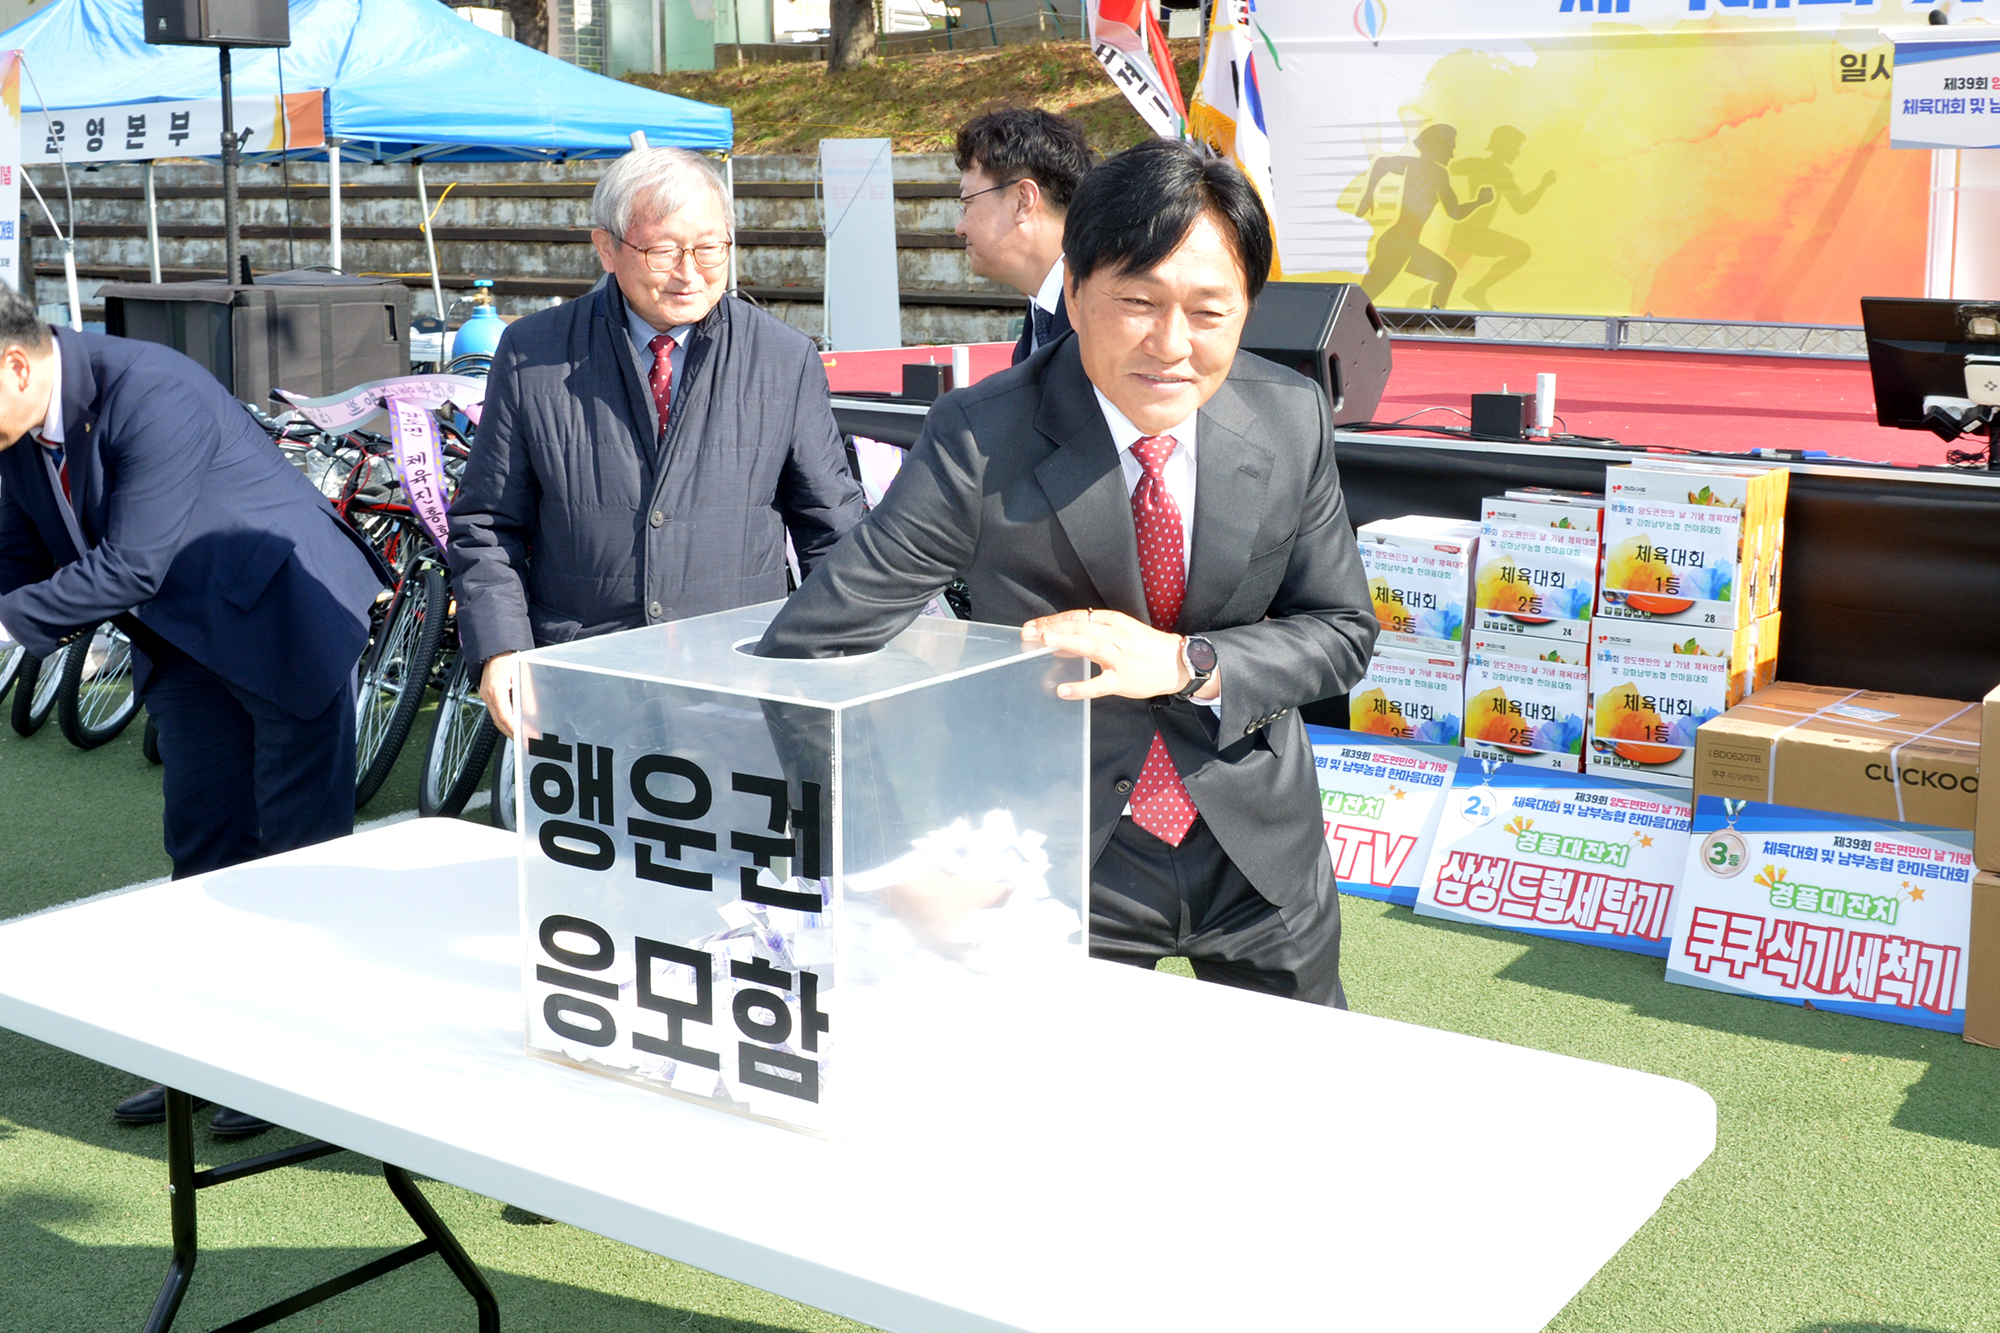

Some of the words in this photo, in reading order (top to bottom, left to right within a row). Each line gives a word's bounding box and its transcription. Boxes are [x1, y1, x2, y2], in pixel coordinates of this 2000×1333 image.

[1943, 77, 1988, 90] 제39회
[1903, 98, 1966, 114] 체육대회
[1970, 98, 1985, 114] 및
[45, 111, 190, 154] 운영본부
[1611, 504, 1634, 514] 제39회
[1638, 507, 1675, 519] 양도면민의
[1679, 510, 1686, 519] 날
[1690, 511, 1704, 520] 기념
[1708, 514, 1738, 524] 체육대회
[1626, 518, 1632, 526] 및
[1636, 518, 1680, 530] 강화남부농협
[1684, 523, 1722, 534] 한마음대회
[1501, 529, 1536, 540] 양도면민의
[1540, 534, 1547, 542] 날
[1551, 534, 1564, 544] 기념
[1568, 536, 1597, 547] 체육대회
[1500, 541, 1541, 553] 강화남부농협
[1544, 546, 1580, 557] 한마음대회
[1635, 544, 1705, 568] 체육대회
[1417, 567, 1452, 580] 한마음대회
[1422, 557, 1436, 566] 기념
[1439, 559, 1467, 570] 체육대회
[1500, 566, 1566, 589] 체육대회
[1655, 576, 1680, 595] 1등
[1375, 586, 1436, 610] 체육대회
[1518, 596, 1544, 615] 2등
[1392, 616, 1416, 634] 3등
[1704, 614, 1716, 623] 28
[1396, 634, 1419, 644] CERAMIC
[1562, 628, 1572, 636] 24
[1372, 662, 1406, 674] 양도면민의
[1409, 667, 1416, 676] 날
[1418, 668, 1432, 678] 기념
[1435, 670, 1462, 681] 체육대회
[1493, 661, 1528, 672] 양도면민의
[1532, 666, 1538, 674] 날
[1542, 668, 1556, 677] 기념
[1559, 670, 1587, 681] 체육대회
[1597, 652, 1620, 664] 제39회
[1623, 656, 1660, 667] 양도면민의
[1664, 660, 1671, 668] 날
[1675, 660, 1690, 670] 기념
[1694, 662, 1724, 672] 체육대회
[1372, 674, 1410, 686] 강화남부농협
[1414, 680, 1448, 690] 한마음대회
[1492, 672, 1534, 685] 강화남부농협
[1537, 678, 1572, 690] 한마음대회
[1612, 666, 1619, 675] 및
[1622, 668, 1666, 680] 강화남부농협
[1670, 672, 1708, 684] 한마음대회
[1373, 698, 1434, 721] 체육대회
[1492, 697, 1556, 722] 체육대회
[1623, 692, 1692, 717] 체육대회
[1510, 728, 1534, 747] 2등
[1644, 725, 1670, 744] 1등
[1340, 748, 1371, 761] 제39회
[1372, 753, 1416, 770] 양도면민의
[1418, 760, 1428, 770] 날
[1430, 762, 1448, 773] 기념
[1552, 760, 1562, 768] 24
[1330, 758, 1341, 770] 및
[1344, 761, 1386, 778] 남부농협
[1388, 768, 1444, 787] 한마음대회
[1712, 770, 1726, 778] 쿠쿠
[1864, 763, 1978, 793] CUCKOO
[1464, 796, 1490, 816] 2등
[1511, 795, 1560, 814] 체육대회
[1563, 802, 1574, 815] 및
[1578, 804, 1627, 824] 남부농협
[1628, 811, 1691, 833] 한마음대회
[1574, 792, 1608, 806] 제39회
[1610, 796, 1660, 814] 양도면민의
[1662, 804, 1674, 815] 날
[1675, 805, 1692, 818] 기념
[528, 733, 822, 913] 행운권
[1516, 828, 1630, 868] 경품대잔치
[1710, 842, 1740, 867] 3등
[1832, 836, 1872, 851] 제39회
[1874, 841, 1931, 861] 양도면민의
[1934, 849, 1946, 862] 날
[1948, 850, 1971, 866] 기념
[1763, 840, 1818, 862] 체육대회
[1821, 849, 1836, 864] 및
[1838, 851, 1894, 873] 남부농협
[1897, 860, 1970, 884] 한마음대회
[1770, 880, 1900, 925] 경품대잔치
[536, 914, 829, 1105] 응모함
